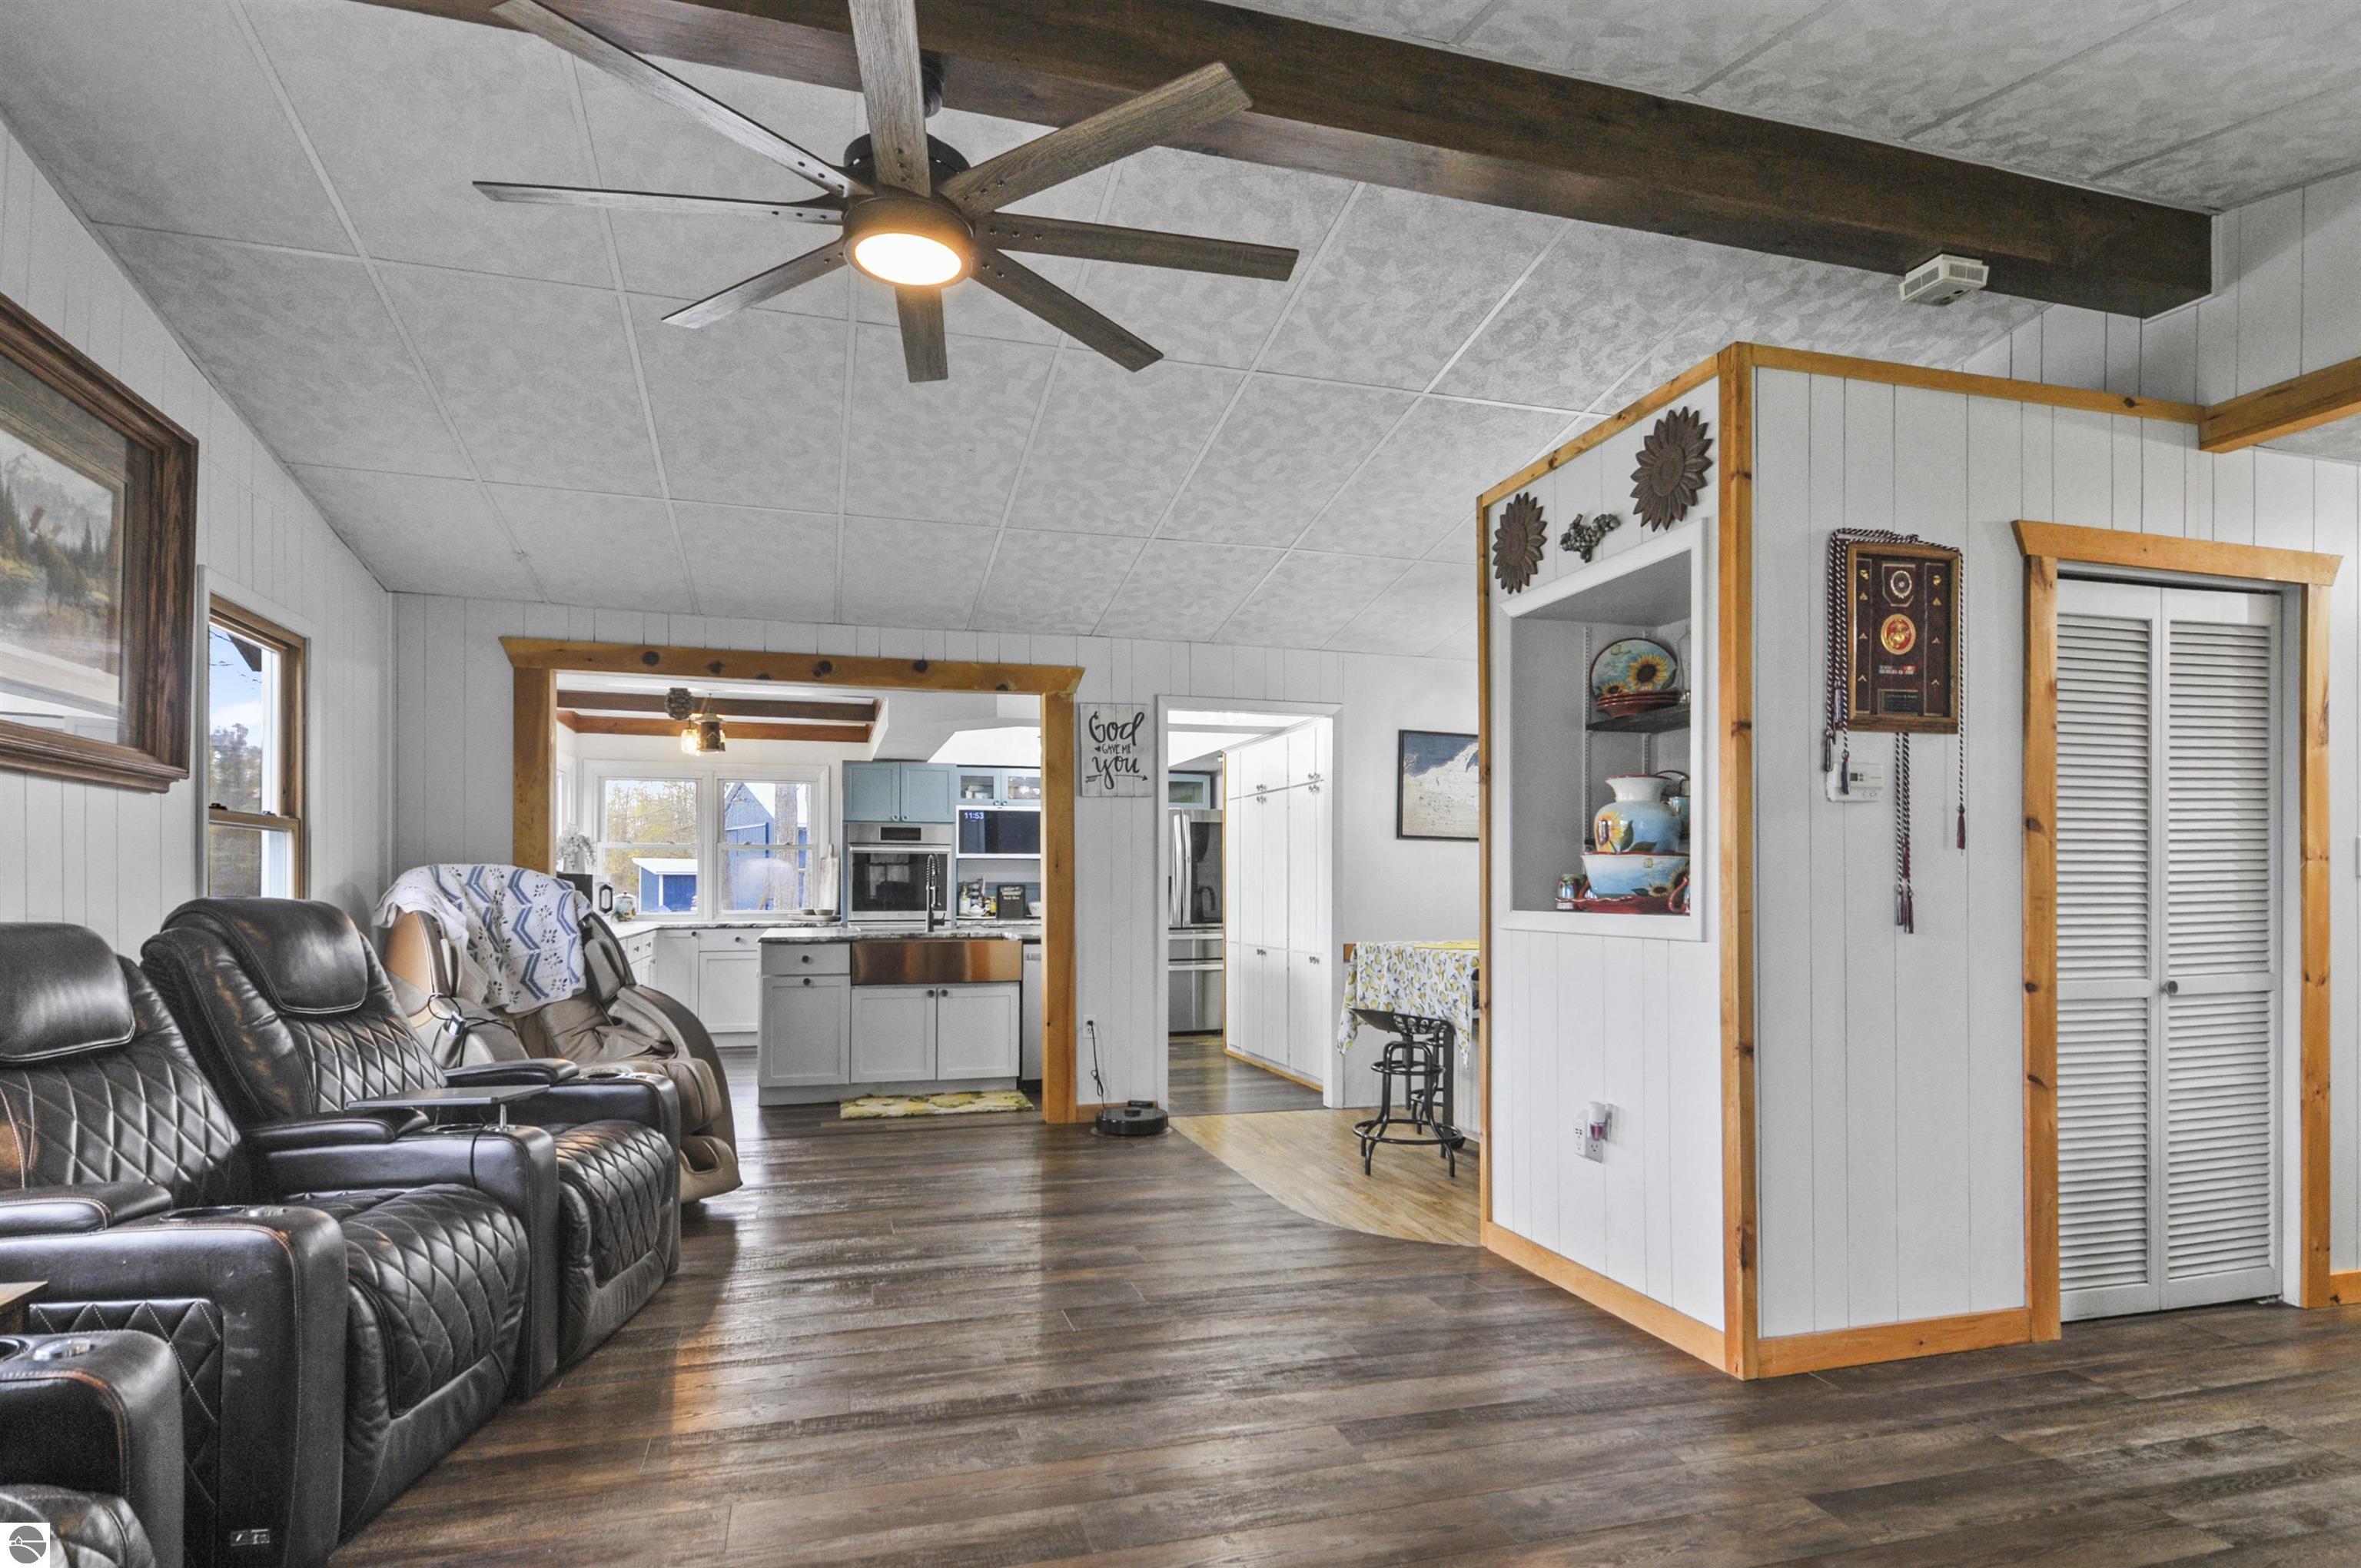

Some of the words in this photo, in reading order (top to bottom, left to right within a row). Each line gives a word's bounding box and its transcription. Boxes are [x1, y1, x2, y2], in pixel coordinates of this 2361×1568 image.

[1088, 711, 1144, 746] God
[1101, 744, 1121, 754] GAVE
[1122, 743, 1132, 754] ME
[1091, 756, 1140, 789] you
